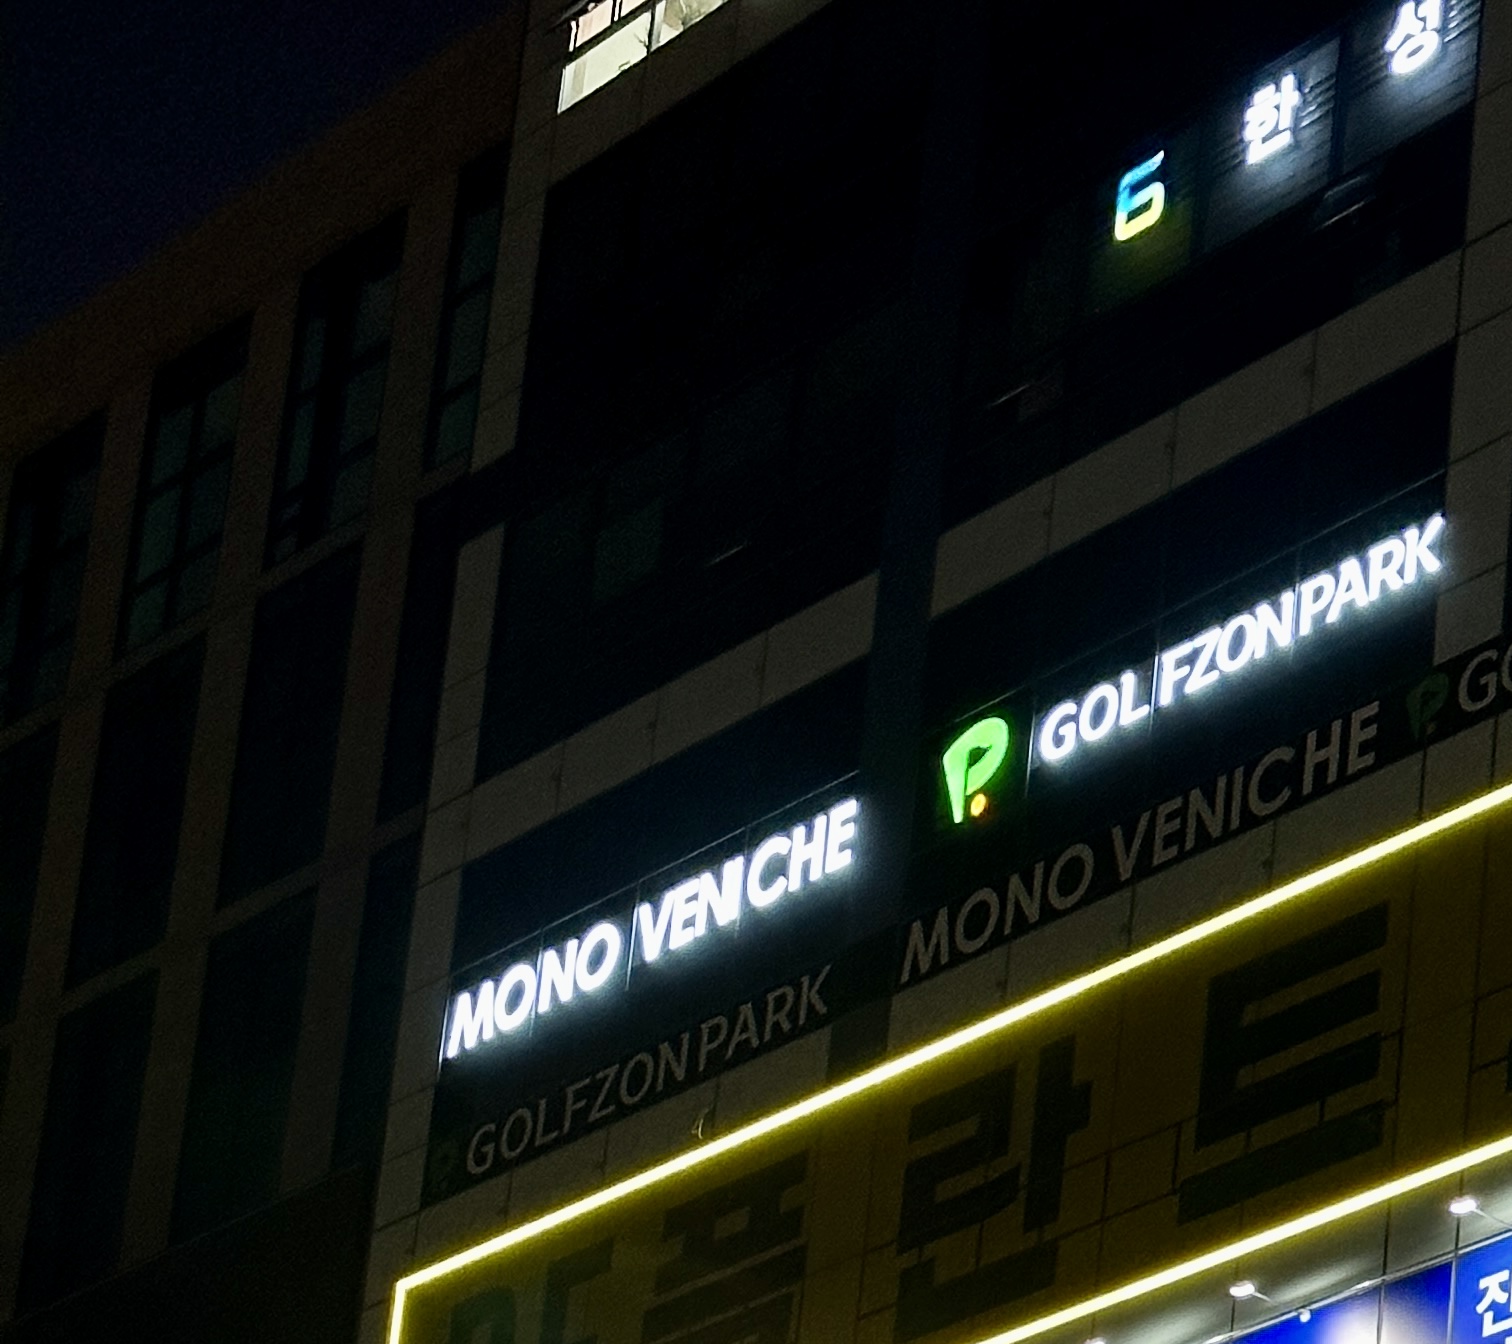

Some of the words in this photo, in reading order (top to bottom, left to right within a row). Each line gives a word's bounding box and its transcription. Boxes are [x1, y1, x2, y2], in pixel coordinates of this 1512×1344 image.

[1038, 513, 1446, 763] GOLFZONPARK
[445, 922, 622, 1060] MONO
[633, 798, 859, 967] VENICHE
[900, 842, 1095, 983] MONO
[1110, 700, 1380, 882] VENICHE
